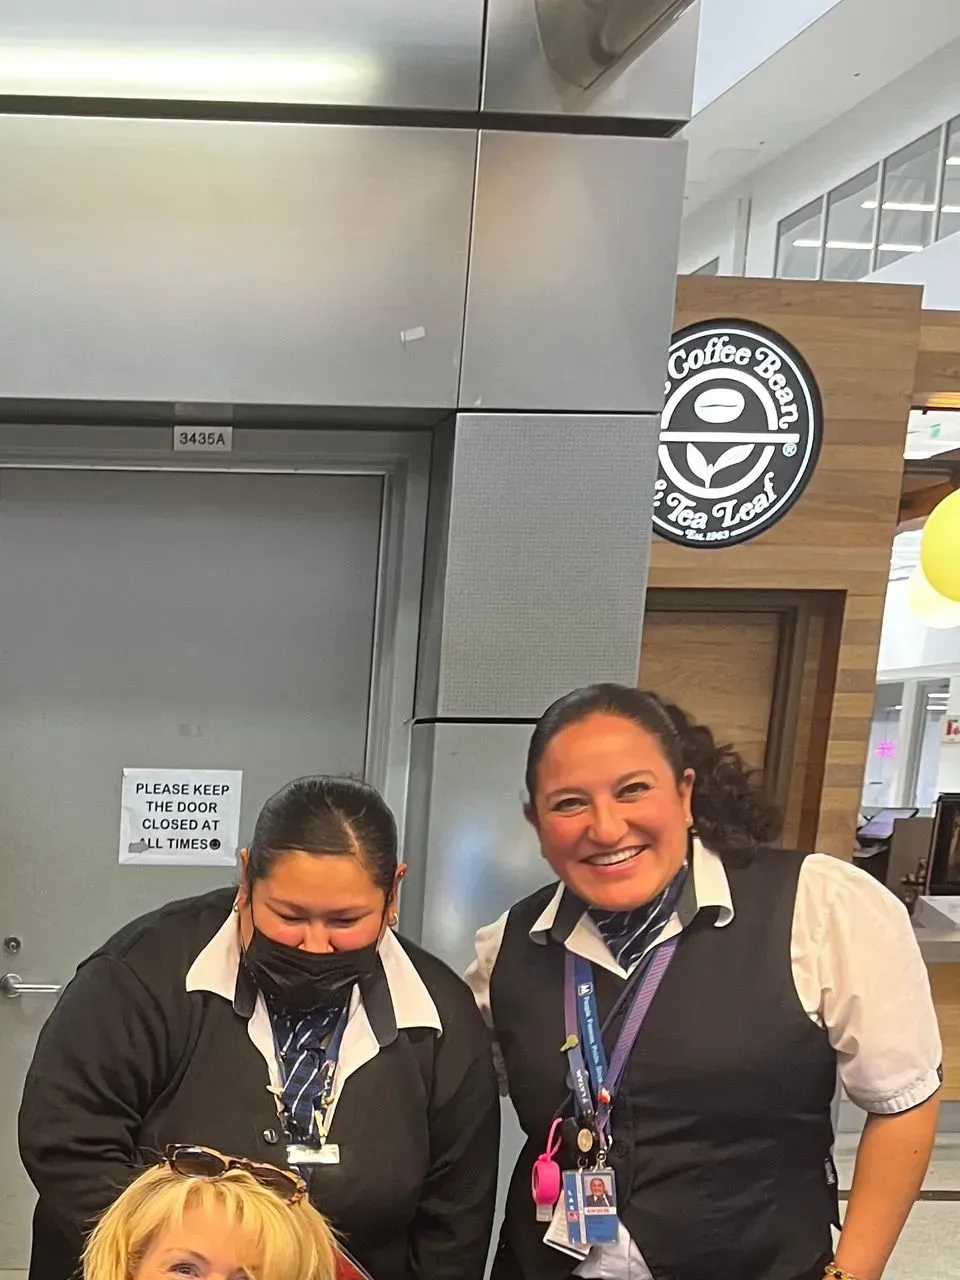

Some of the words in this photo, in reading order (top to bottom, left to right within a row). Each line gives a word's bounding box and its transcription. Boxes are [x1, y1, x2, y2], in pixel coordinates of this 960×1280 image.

[668, 336, 752, 379] Coffee
[753, 347, 799, 430] Bean
[179, 432, 225, 445] 3435A
[666, 492, 708, 529] Tea
[712, 472, 778, 528] Leaf
[136, 783, 189, 795] PLEASE
[193, 784, 230, 796] KEEP
[145, 801, 173, 812] THE
[177, 802, 217, 813] DOOR
[142, 818, 198, 830] CLOSED
[201, 820, 220, 831] AT
[167, 838, 208, 850] TIMES
